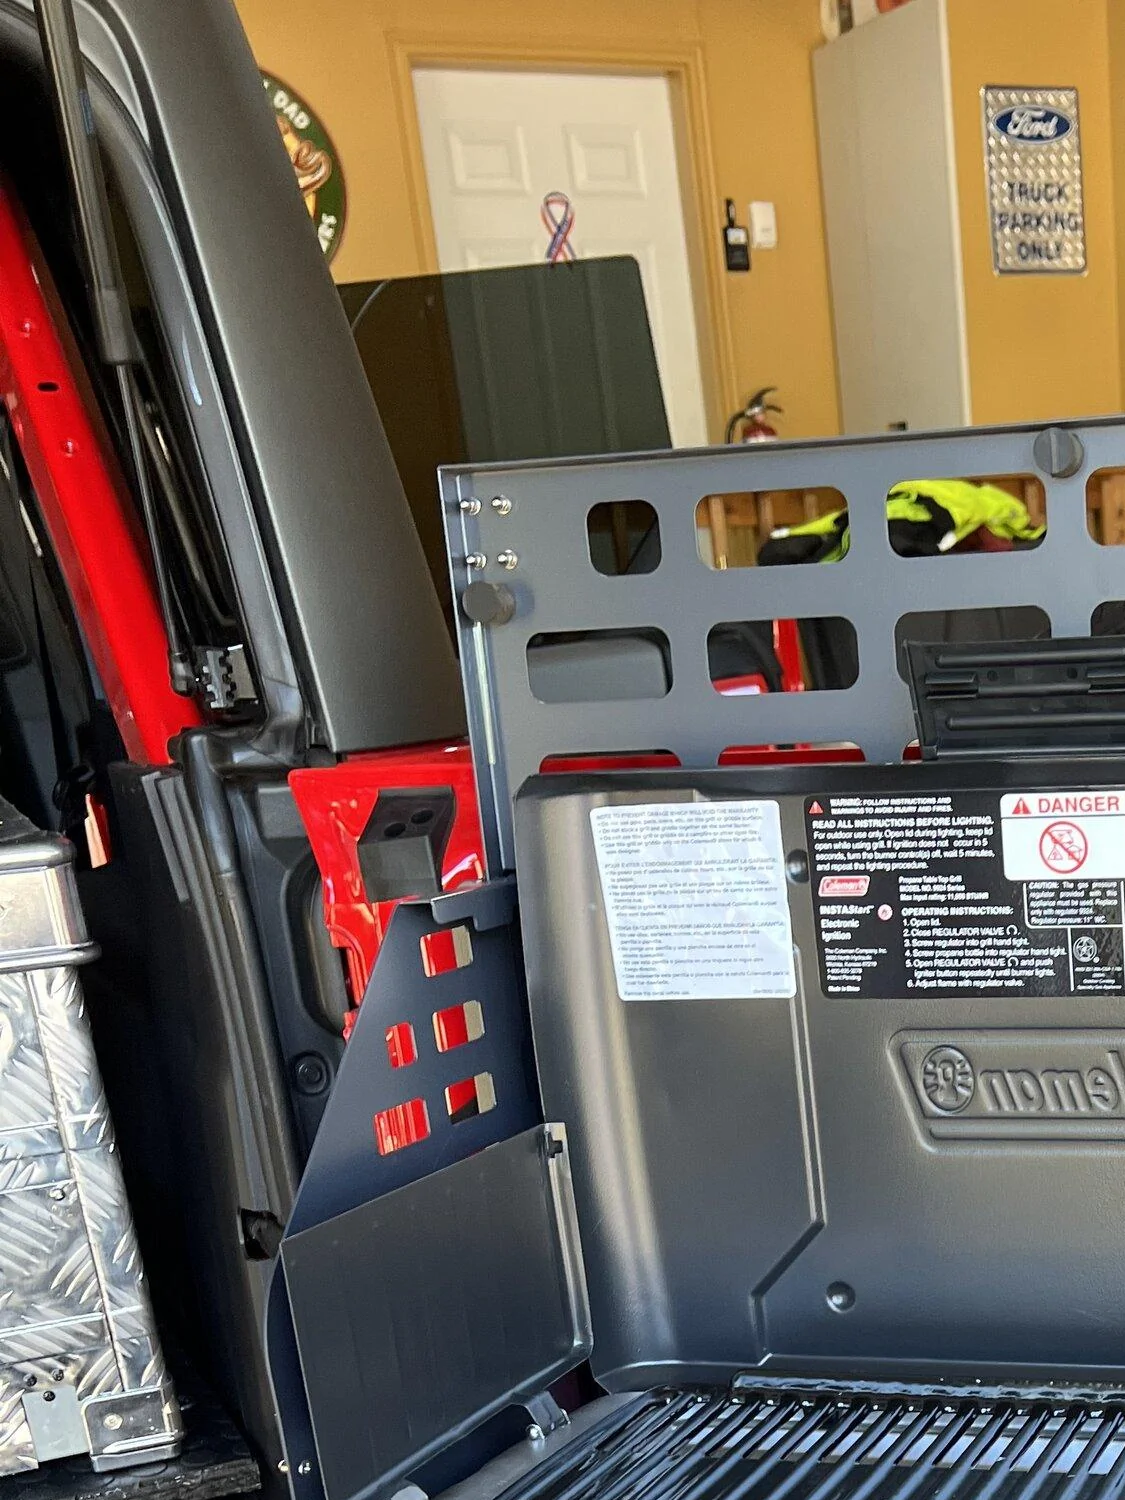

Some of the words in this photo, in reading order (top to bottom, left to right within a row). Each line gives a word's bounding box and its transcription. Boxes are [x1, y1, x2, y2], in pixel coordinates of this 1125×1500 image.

[273, 89, 310, 129] DAD
[1007, 109, 1059, 138] Ford
[1007, 181, 1065, 202] TRUCK
[998, 212, 1079, 232] PARKING
[1017, 241, 1063, 260] ONLY
[1038, 796, 1120, 813] DANGER
[813, 819, 835, 828] READ
[837, 819, 852, 828] ALL
[854, 818, 914, 827] INSTRUCTIONS
[916, 817, 950, 826] BEFORE
[951, 816, 994, 825] LIGHTING.
[902, 907, 948, 916] OPERATING
[950, 906, 1013, 915] INSTRUCTIONS:
[821, 919, 860, 928] Electronic
